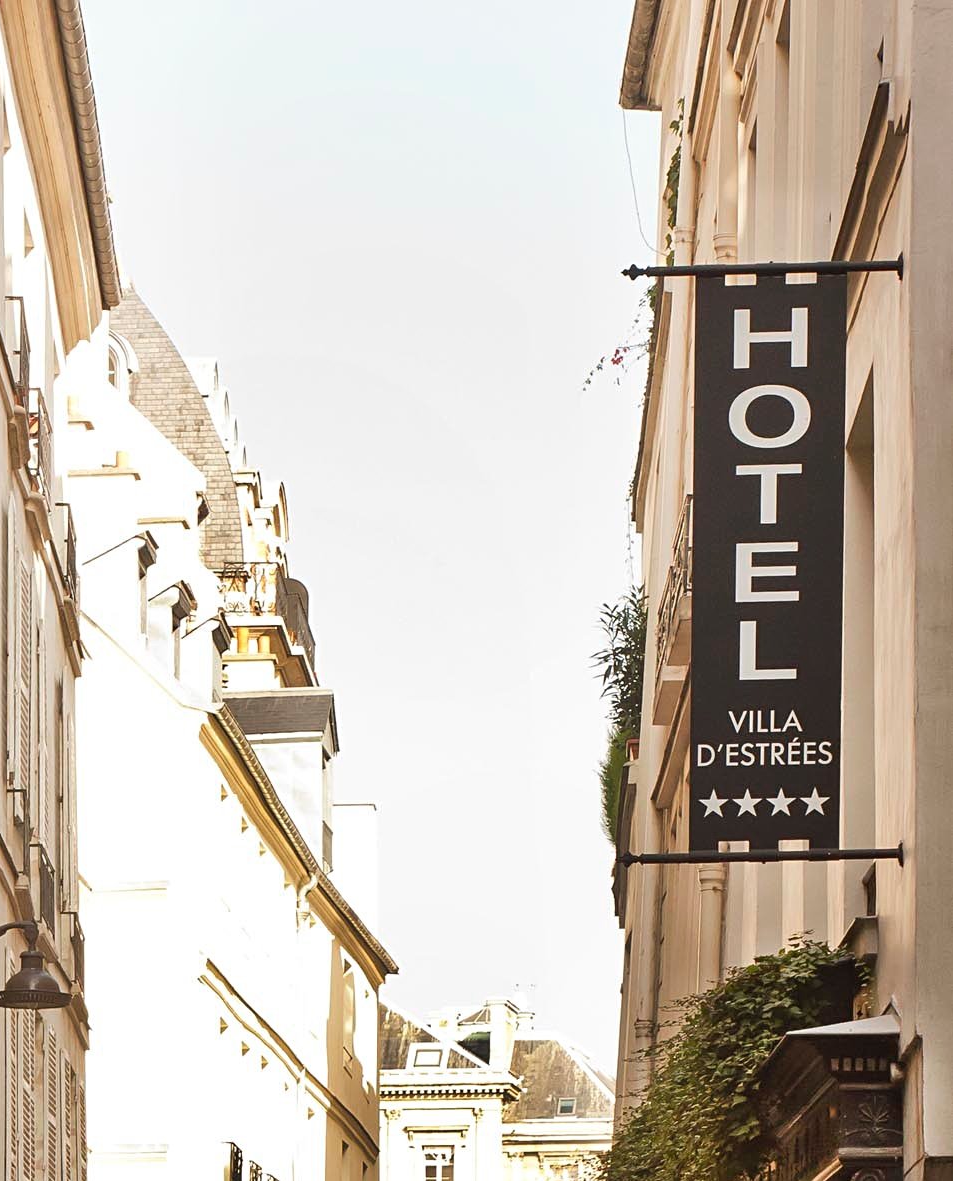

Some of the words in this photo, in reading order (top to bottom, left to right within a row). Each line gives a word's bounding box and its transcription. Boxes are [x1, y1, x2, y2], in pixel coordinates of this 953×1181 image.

[729, 307, 811, 681] HOTEL
[728, 709, 803, 734] VILLA
[697, 737, 833, 767] D'ESTRÉES
